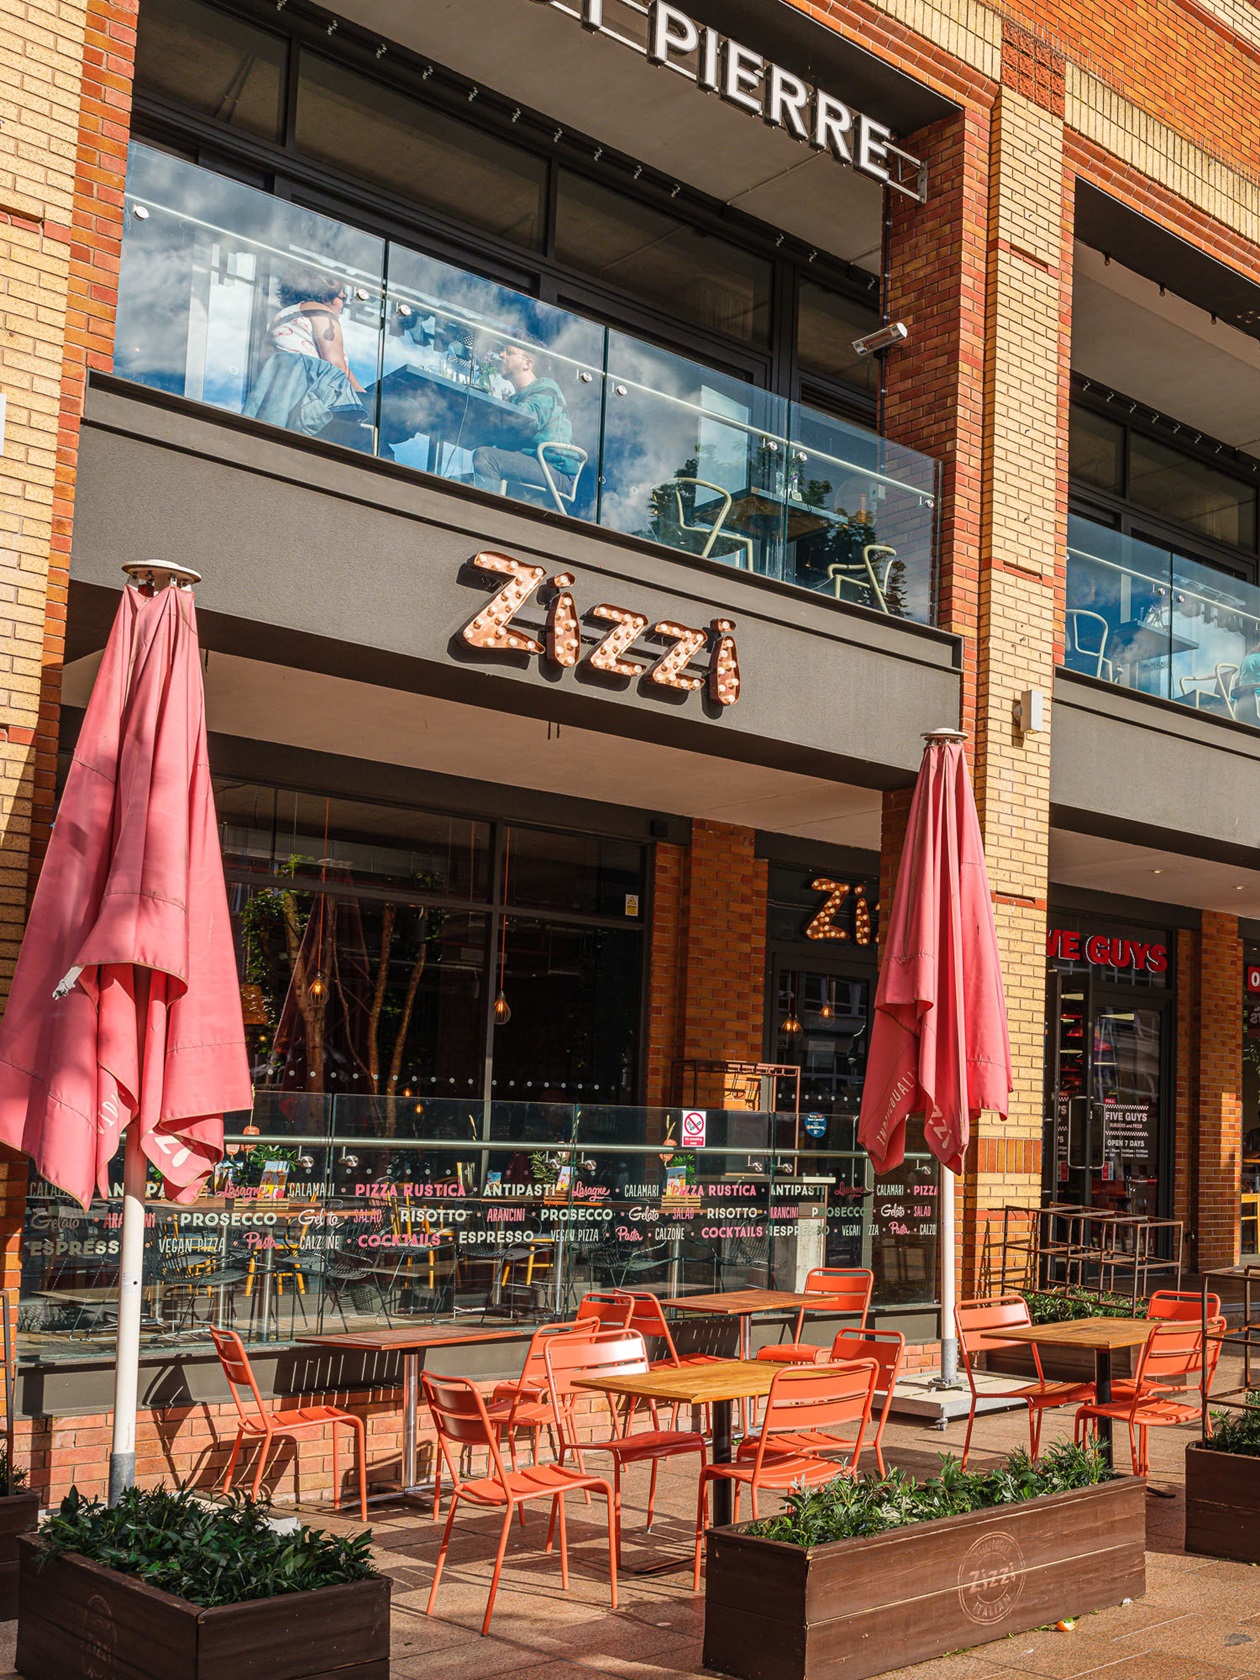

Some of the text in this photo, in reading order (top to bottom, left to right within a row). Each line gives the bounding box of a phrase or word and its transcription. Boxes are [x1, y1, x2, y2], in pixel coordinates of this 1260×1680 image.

[650, 0, 892, 183] PIERRE
[463, 551, 740, 706] Zizzi
[1046, 928, 1167, 973] VE GUYS
[1105, 1112, 1147, 1122] FIVE GUYS
[215, 1180, 269, 1202] Lasagne
[289, 1183, 335, 1197] CALAMAI
[355, 1184, 398, 1197] PIZZA
[403, 1183, 466, 1197] RUSTICA
[483, 1184, 556, 1197] ANTIPASTI
[571, 1181, 610, 1201] Lasagne
[624, 1184, 659, 1197] CALAMARI
[672, 1184, 704, 1197] PIZZA
[708, 1184, 757, 1197] RUSTICA
[876, 1184, 904, 1196] CALAMARI
[30, 1213, 79, 1230] Gelato
[180, 1212, 277, 1226] PROSECCO
[298, 1208, 339, 1226] Gelto
[353, 1209, 382, 1223] SALAD
[400, 1209, 467, 1222] RISOTTO
[487, 1208, 526, 1222] ARANCINI
[541, 1208, 613, 1221] PROSECCO
[628, 1206, 660, 1222] Gelato
[672, 1207, 695, 1220] SALAD
[707, 1207, 758, 1219] RISOTTO
[881, 1204, 905, 1217] Gelato
[913, 1206, 931, 1217] SALAD
[30, 1240, 119, 1256] ESPRESS
[158, 1238, 193, 1253] VEGAN
[197, 1237, 225, 1252] PIZZA
[243, 1231, 280, 1250] Pasta
[300, 1235, 339, 1250] CALZNE
[358, 1234, 441, 1248] COCKTAILS
[459, 1230, 534, 1243] ESPRESSO
[551, 1229, 576, 1242] VEGAN
[578, 1229, 599, 1242] PIZZA
[615, 1225, 643, 1242] Pasta
[655, 1227, 685, 1241] CALZONE
[701, 1226, 763, 1239] COCKTAILS
[888, 1221, 910, 1234] Pasta
